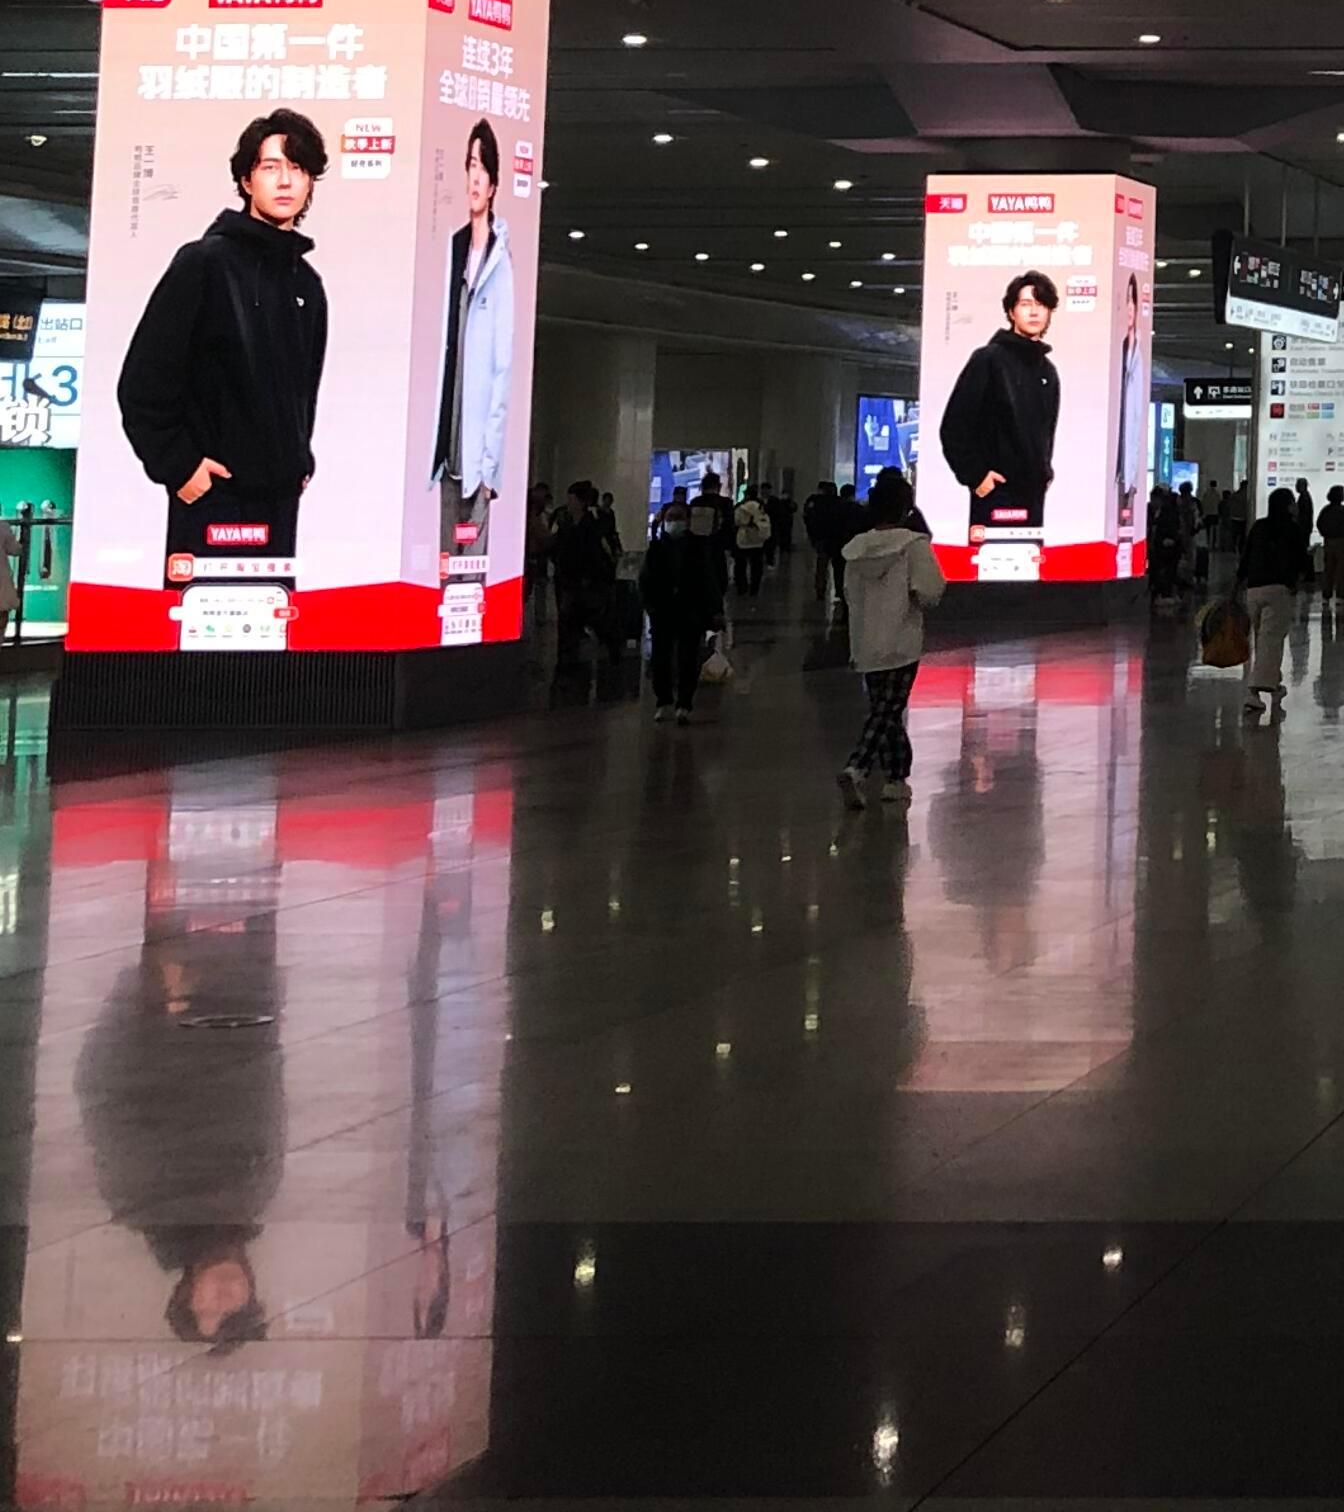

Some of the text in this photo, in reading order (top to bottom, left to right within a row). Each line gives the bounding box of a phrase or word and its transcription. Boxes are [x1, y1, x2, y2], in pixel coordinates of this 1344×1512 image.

[176, 23, 365, 60] 中国第一件
[40, 317, 84, 331] 出站口
